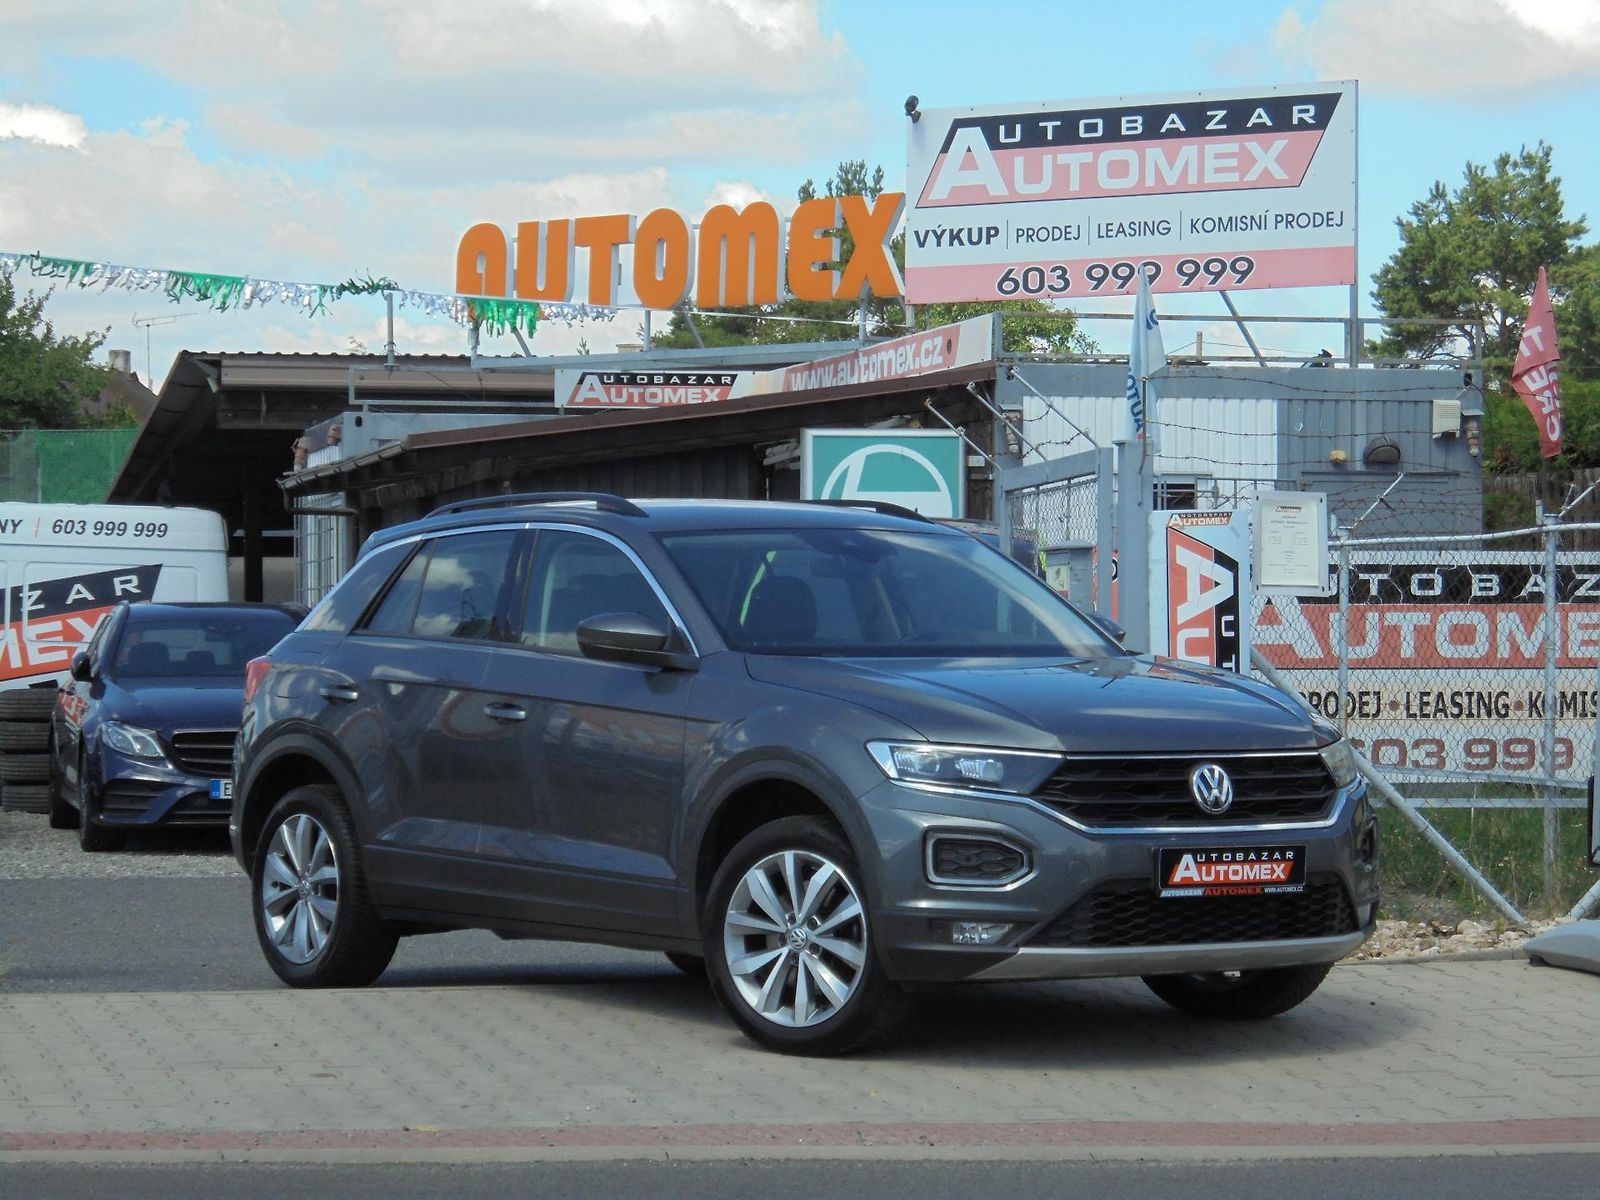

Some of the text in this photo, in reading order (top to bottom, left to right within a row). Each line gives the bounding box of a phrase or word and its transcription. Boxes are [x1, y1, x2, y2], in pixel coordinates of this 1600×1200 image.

[927, 126, 1289, 201] AUTOMEX
[913, 209, 1345, 249] VÝKUP PRODEJ LEASING KOMISNÍ PRODEJ
[455, 192, 906, 309] AUTOMEX
[997, 255, 1255, 296] 603 999 999
[791, 335, 944, 392] www.automex.cz
[574, 374, 722, 404] AUTOMEX
[52, 519, 87, 536] 603
[92, 520, 128, 537] 999
[133, 522, 168, 538] 999
[1168, 513, 1228, 526] AUTOMEX
[1299, 690, 1382, 718] RODEJ
[1405, 690, 1509, 719] LEASING
[1349, 737, 1446, 771] 03
[1173, 854, 1286, 883] AUTOMEX
